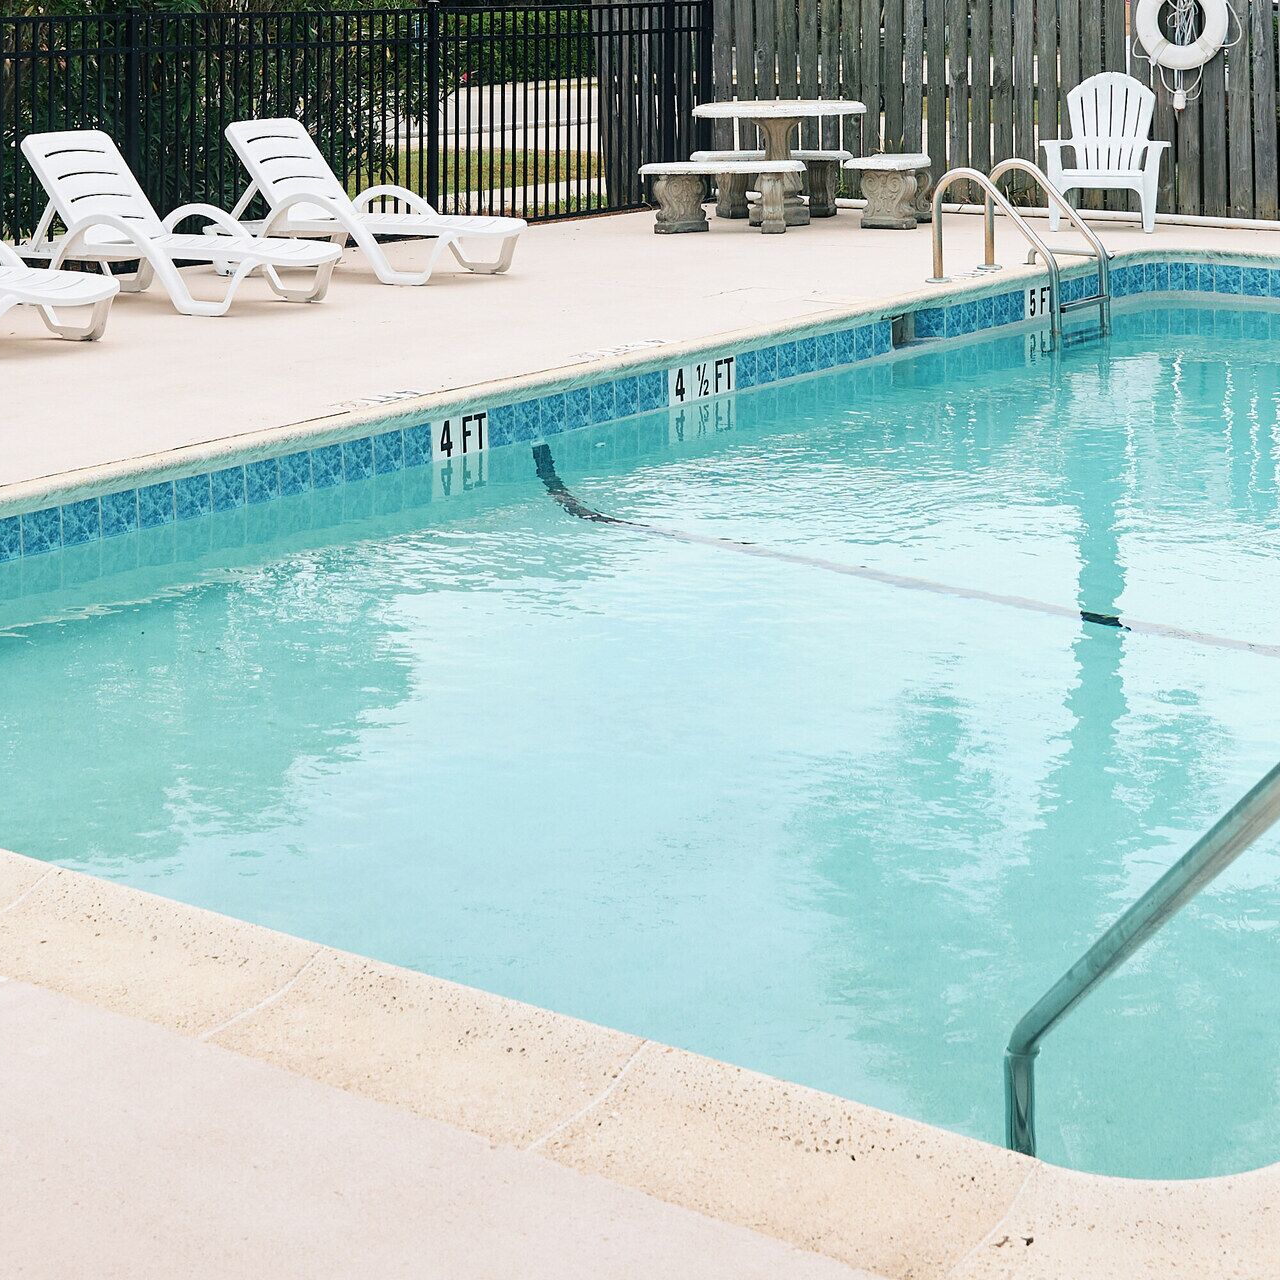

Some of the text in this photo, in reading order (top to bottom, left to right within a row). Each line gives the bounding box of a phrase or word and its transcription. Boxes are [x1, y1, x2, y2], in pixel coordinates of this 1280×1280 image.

[1029, 288, 1036, 317] 5
[675, 368, 686, 402] 4
[713, 356, 735, 392] FT
[439, 413, 487, 458] 4 FT
